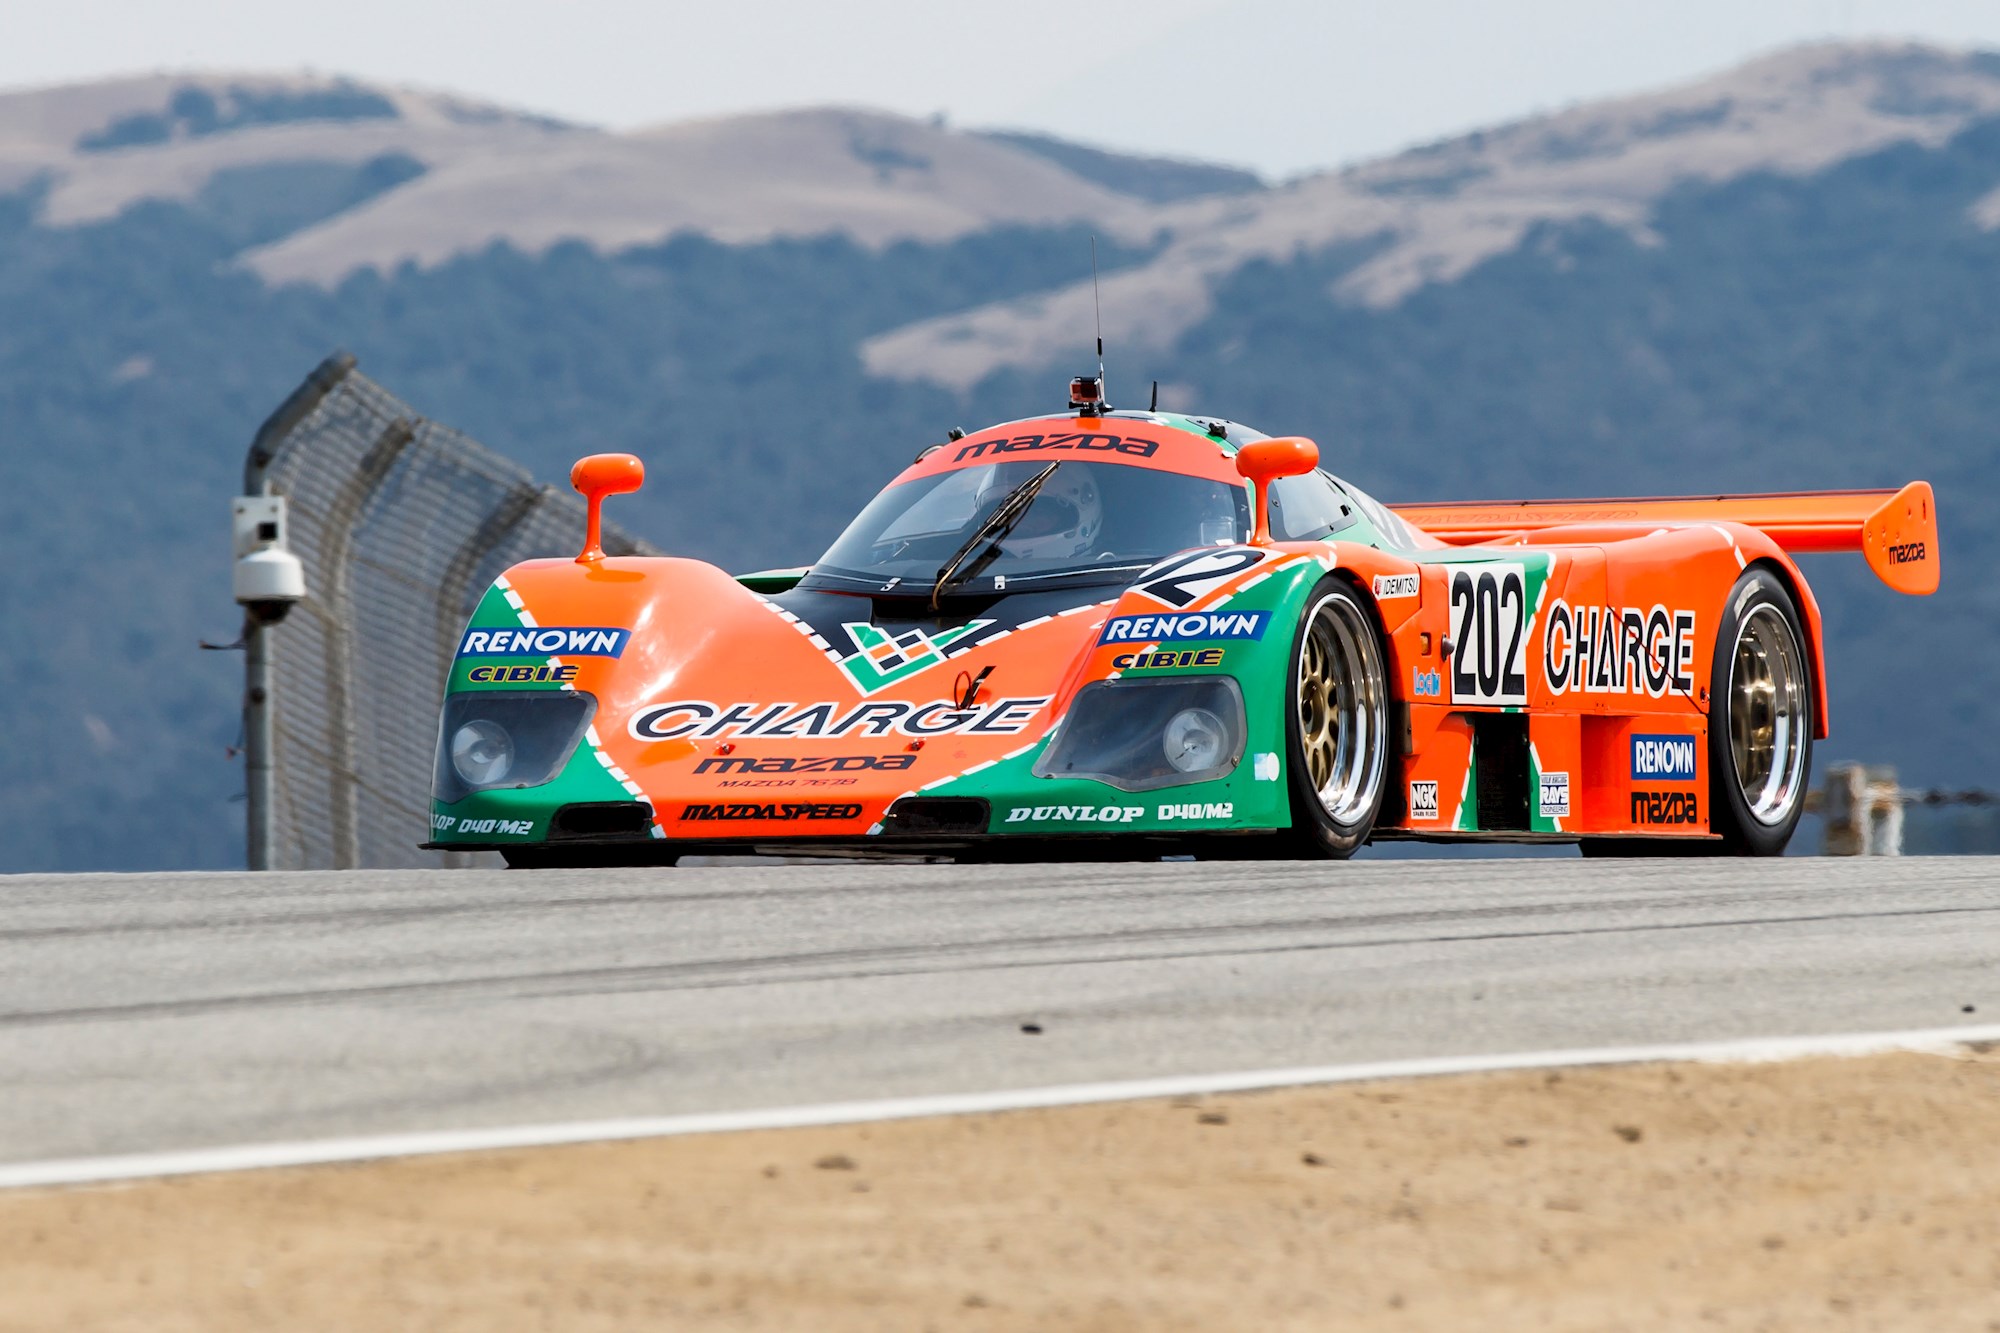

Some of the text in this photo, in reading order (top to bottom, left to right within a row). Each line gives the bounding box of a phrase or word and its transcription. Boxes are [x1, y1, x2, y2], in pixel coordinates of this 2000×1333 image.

[1888, 542, 1926, 565] mazda
[1383, 577, 1419, 595] IDEMITSU
[1106, 614, 1260, 641] RENOWN
[1451, 571, 1526, 697] 202
[463, 629, 620, 654] RENOWN
[1544, 599, 1696, 698] CHARGE
[627, 694, 1059, 742] CHARGE
[692, 754, 920, 775] mazda
[1635, 740, 1694, 774] RENOWN
[717, 779, 797, 788] MAZDA
[1540, 786, 1569, 804] RAYS
[1412, 784, 1437, 809] NGK
[679, 803, 863, 821] MAZDASPEED
[1005, 803, 1233, 823] DUNLOP D40/M2
